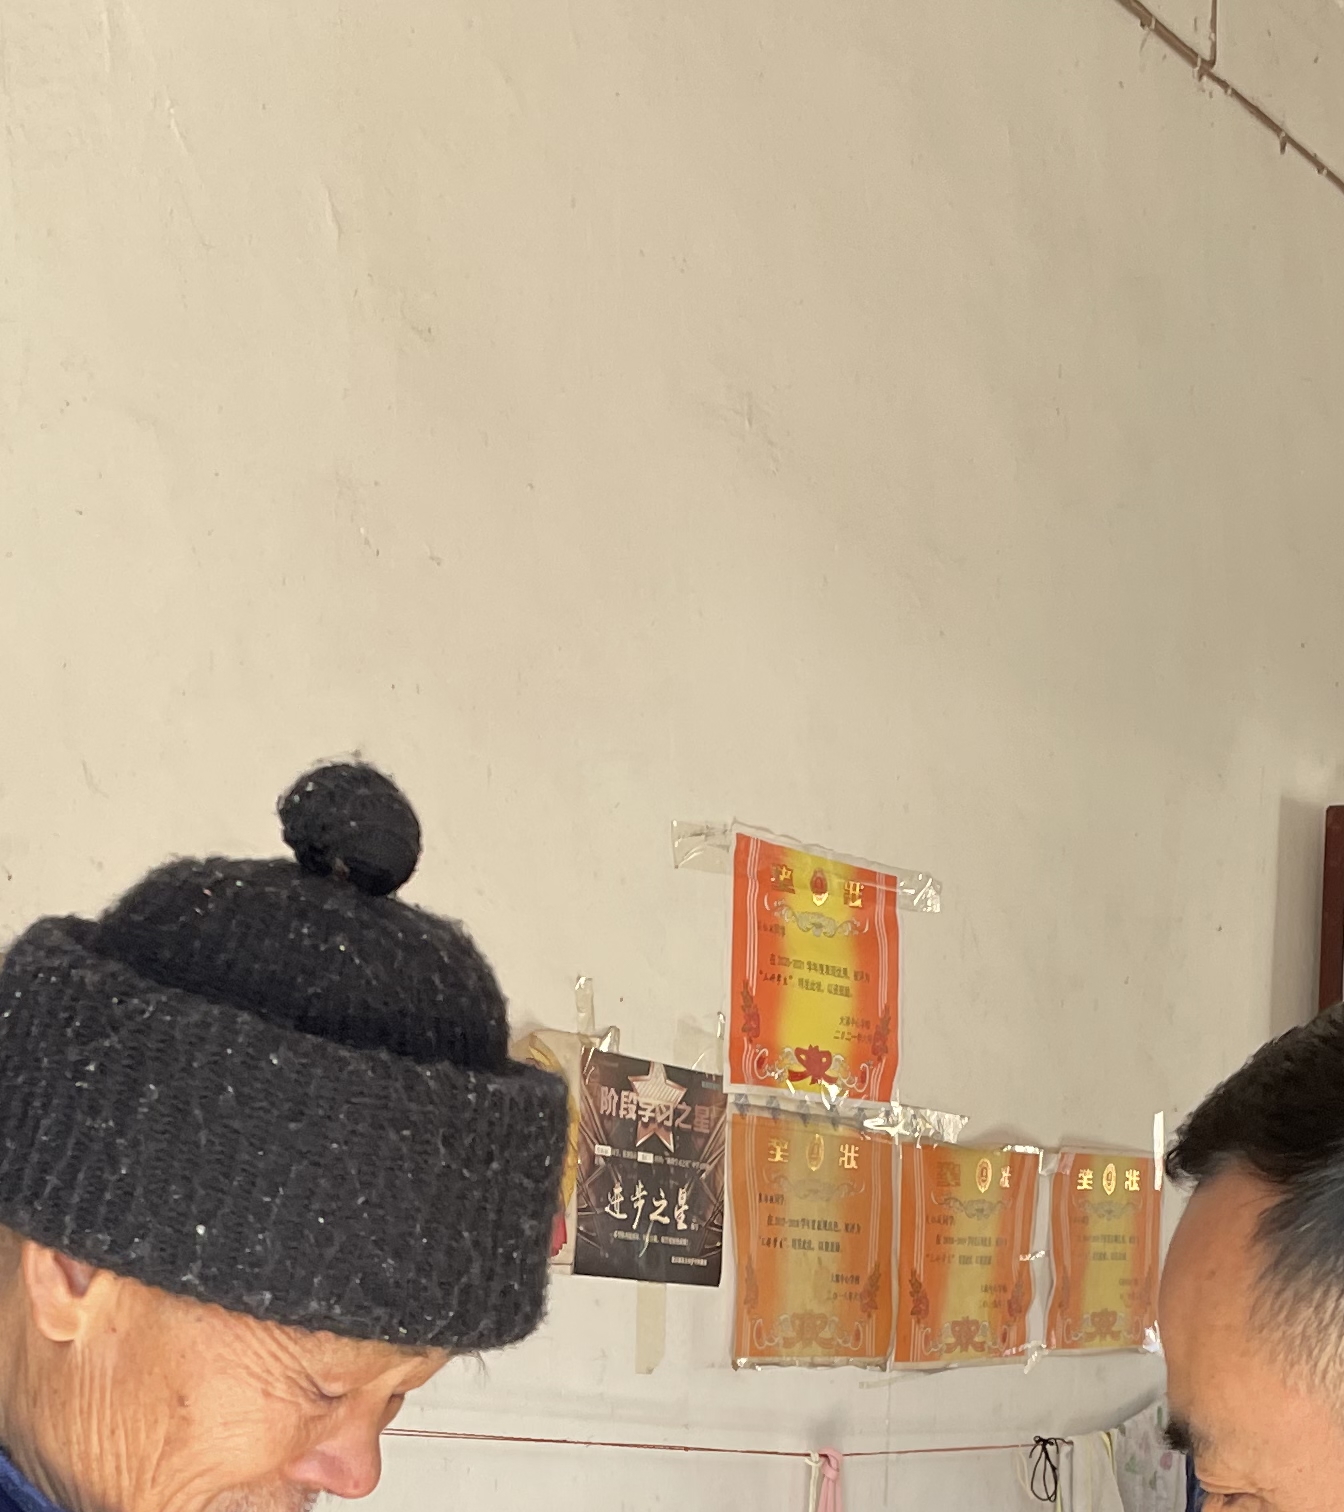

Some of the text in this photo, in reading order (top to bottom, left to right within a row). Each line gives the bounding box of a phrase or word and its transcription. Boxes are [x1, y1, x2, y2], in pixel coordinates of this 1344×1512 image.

[599, 1086, 711, 1134] 阶段学习之星
[604, 1179, 692, 1231] 进步之星
